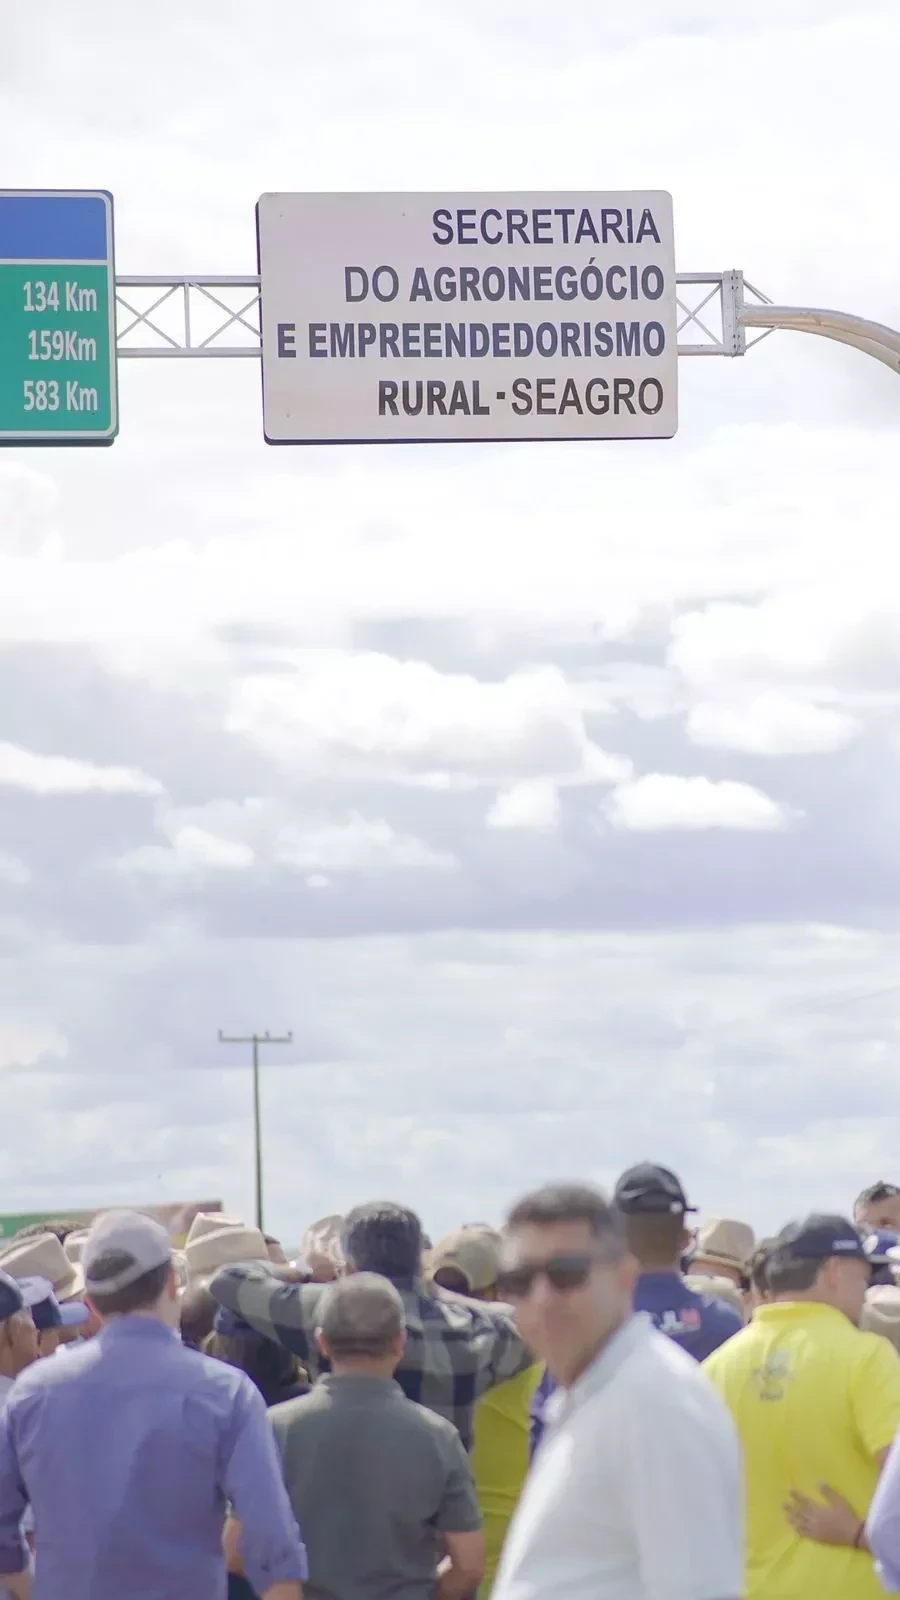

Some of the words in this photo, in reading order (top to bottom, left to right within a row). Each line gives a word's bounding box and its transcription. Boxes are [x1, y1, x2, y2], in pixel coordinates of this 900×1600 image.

[432, 208, 661, 245] SECRETARIA
[22, 280, 59, 311] 134
[65, 282, 98, 312] Km
[345, 265, 400, 302] DO
[409, 257, 664, 302] AGRONEGÓCIO
[277, 323, 296, 358] E
[309, 321, 665, 358] EMPREENDEDORISMO
[22, 379, 59, 411] 583
[65, 381, 98, 412] Km
